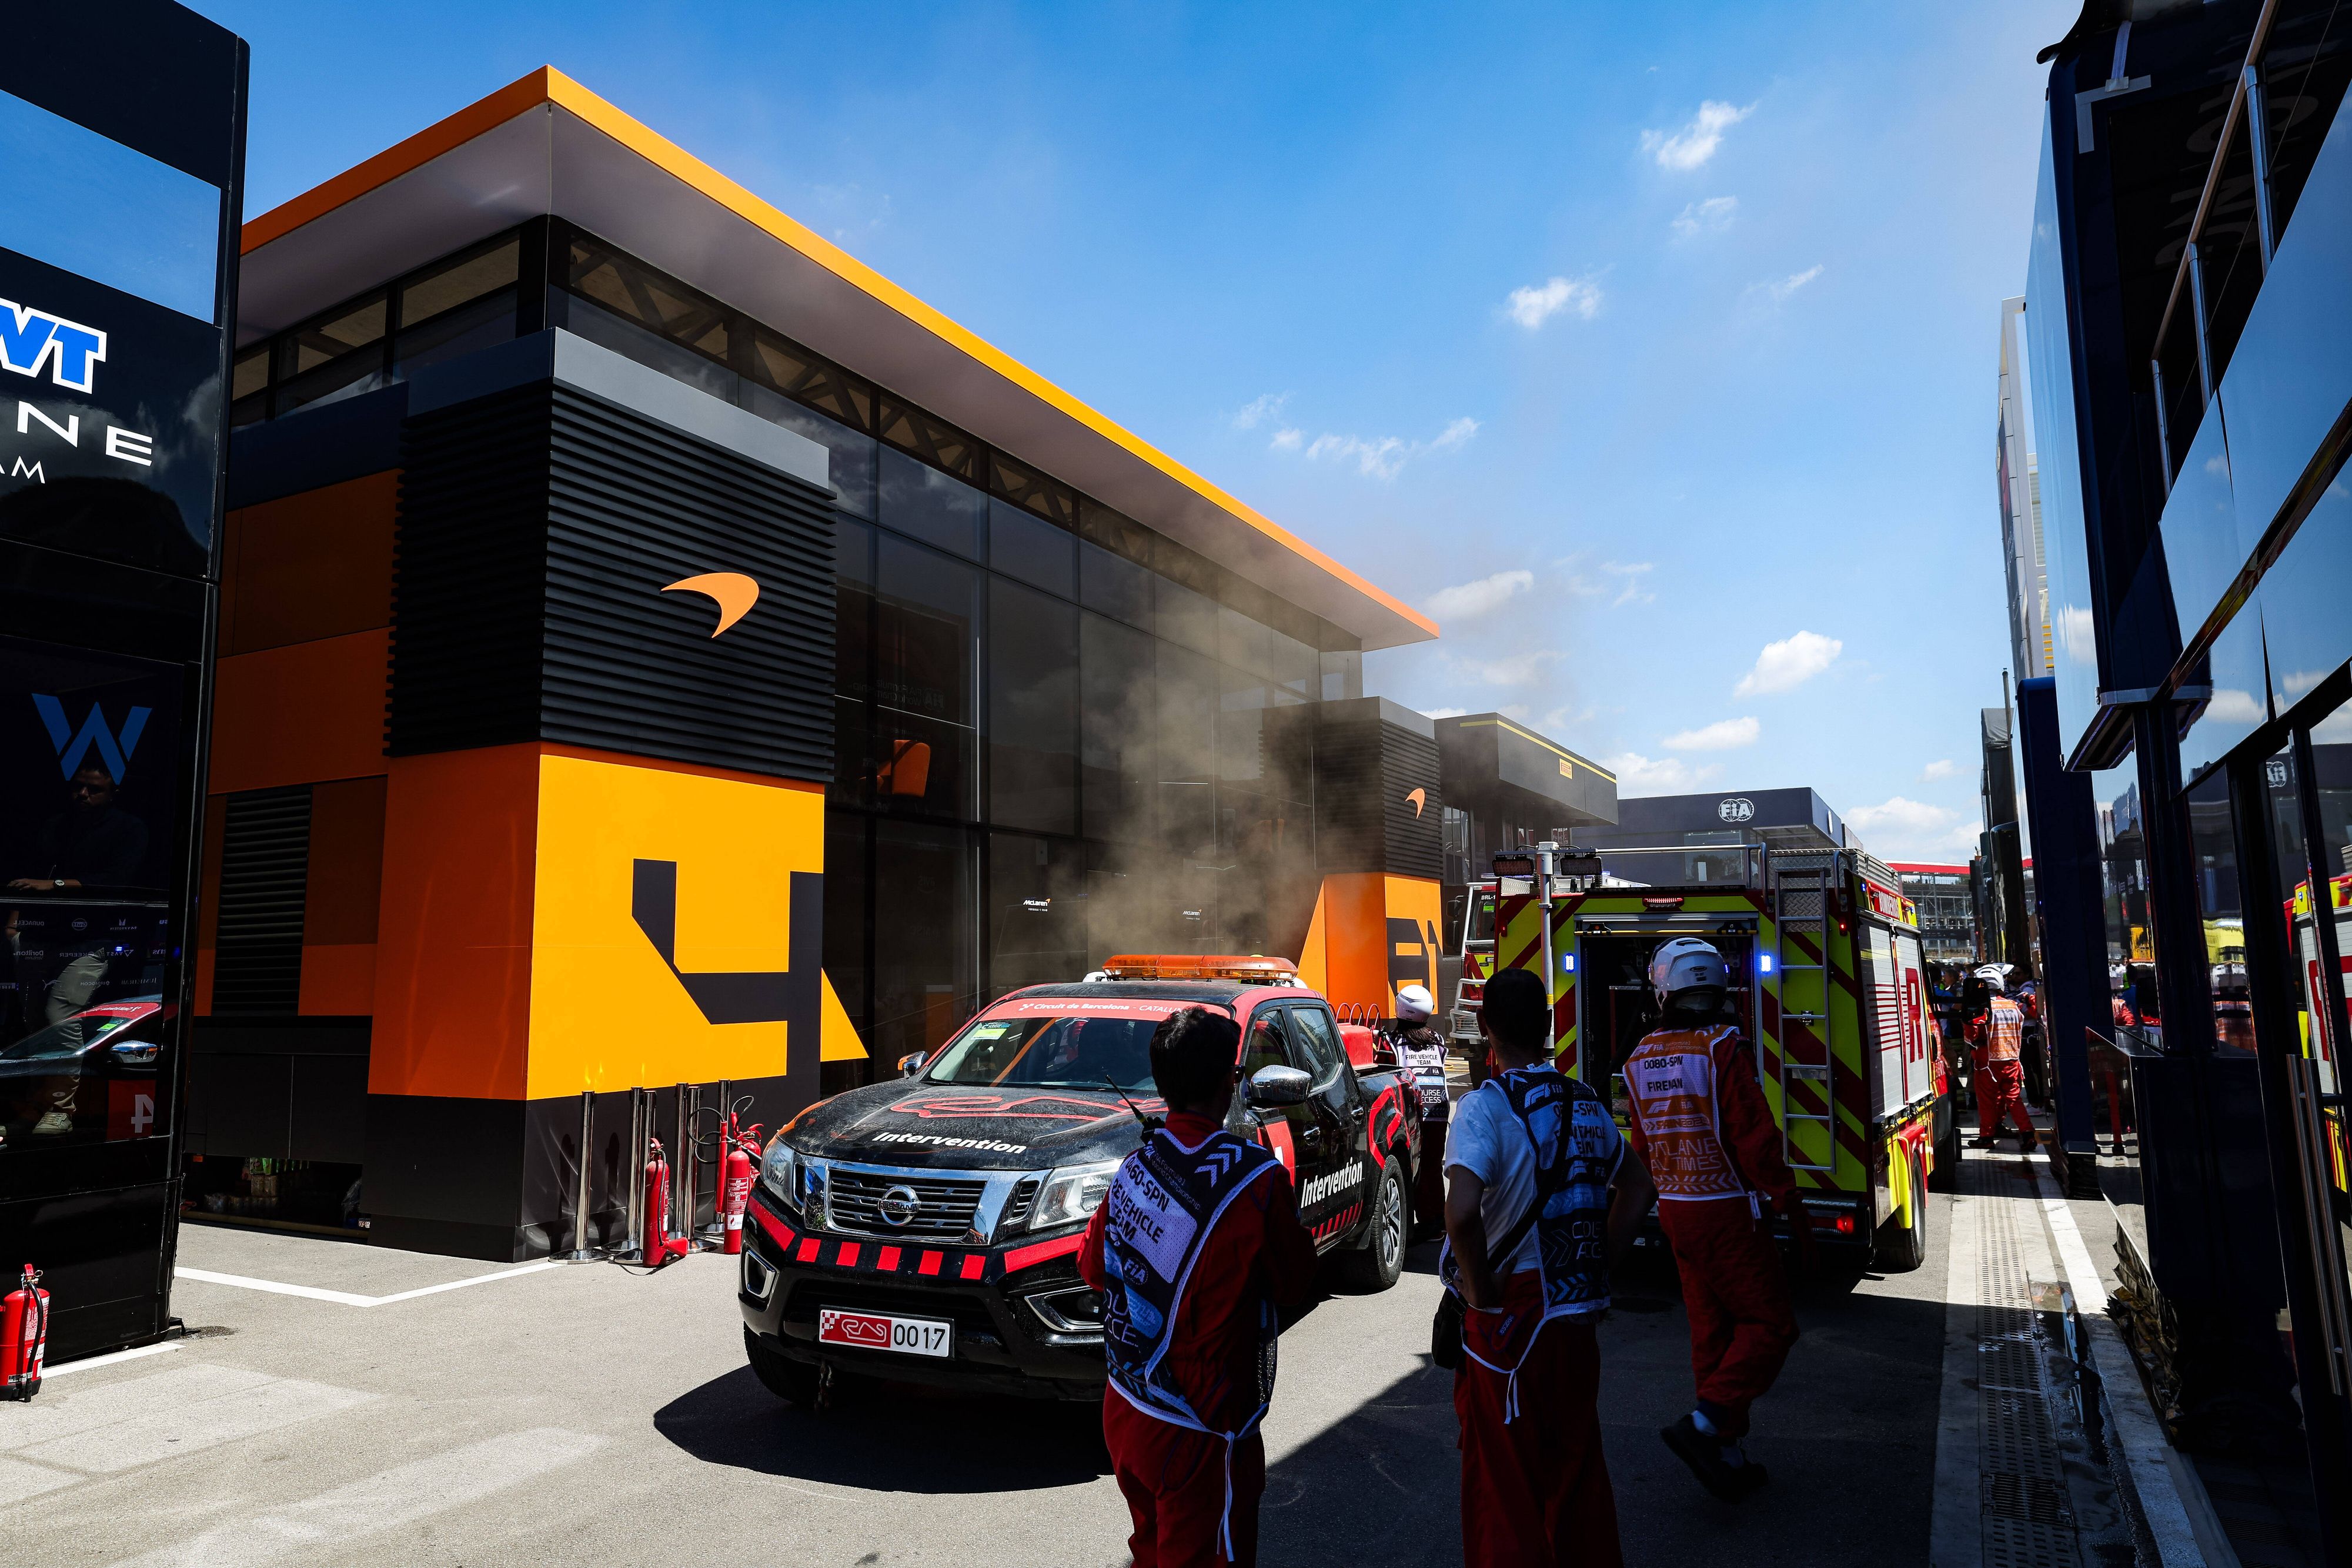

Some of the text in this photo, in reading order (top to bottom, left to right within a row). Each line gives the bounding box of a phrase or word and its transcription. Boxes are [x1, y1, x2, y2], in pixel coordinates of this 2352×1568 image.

[1644, 1056, 1683, 1069] 0080-SPN
[1647, 1078, 1683, 1092] FIREMAN
[871, 1132, 1027, 1154] Intervention
[1301, 1156, 1362, 1209] Intervention
[880, 1201, 913, 1212] NISSAN
[1121, 1191, 1164, 1245] VEHICLE
[893, 1323, 946, 1350] 0017
